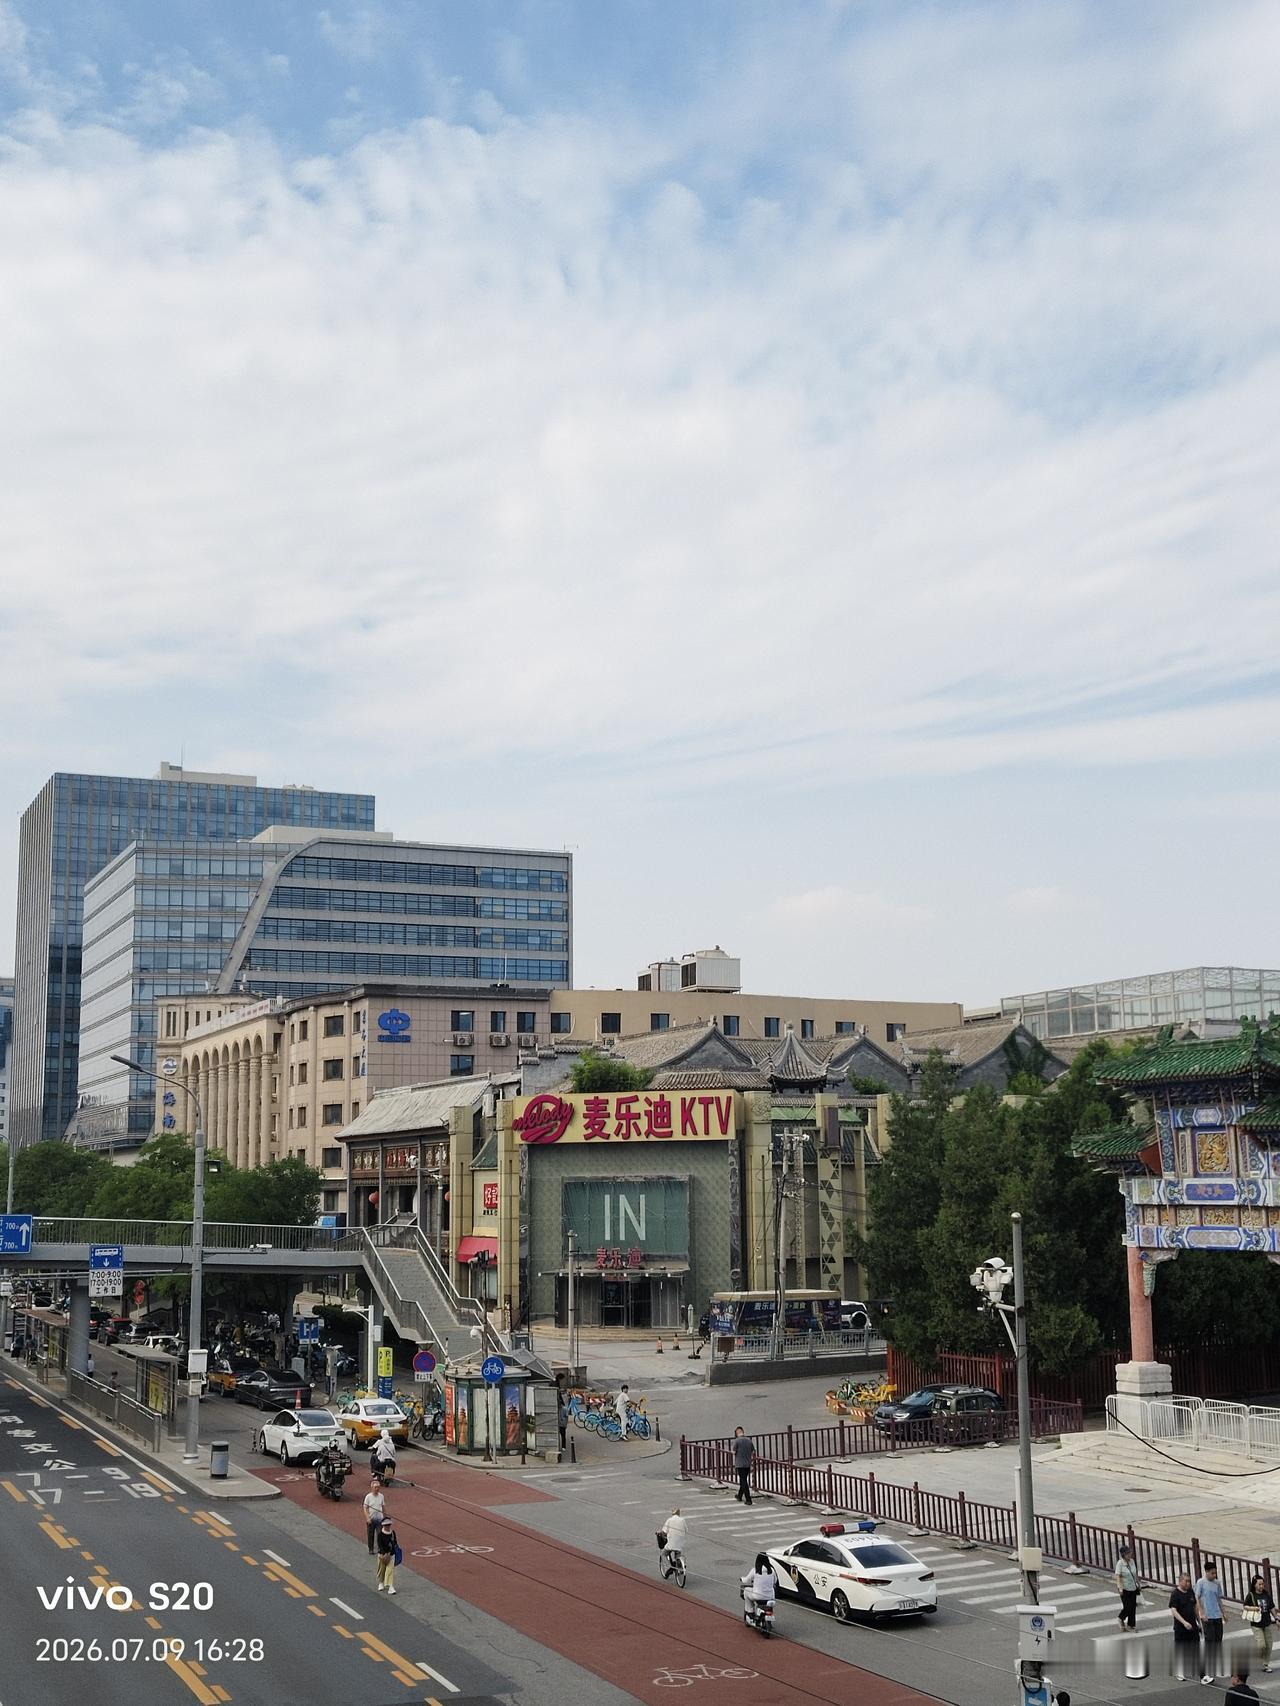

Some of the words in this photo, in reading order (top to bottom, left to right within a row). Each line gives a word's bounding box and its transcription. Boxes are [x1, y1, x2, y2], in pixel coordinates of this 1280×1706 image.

[582, 1094, 674, 1141] 麦乐迪
[680, 1095, 732, 1136] KTV
[604, 1194, 646, 1241] IN
[596, 1246, 642, 1270] 麦乐迪
[90, 1279, 121, 1287] 17:00-19:00
[95, 1286, 116, 1294] 工作日
[814, 1573, 828, 1588] 公安
